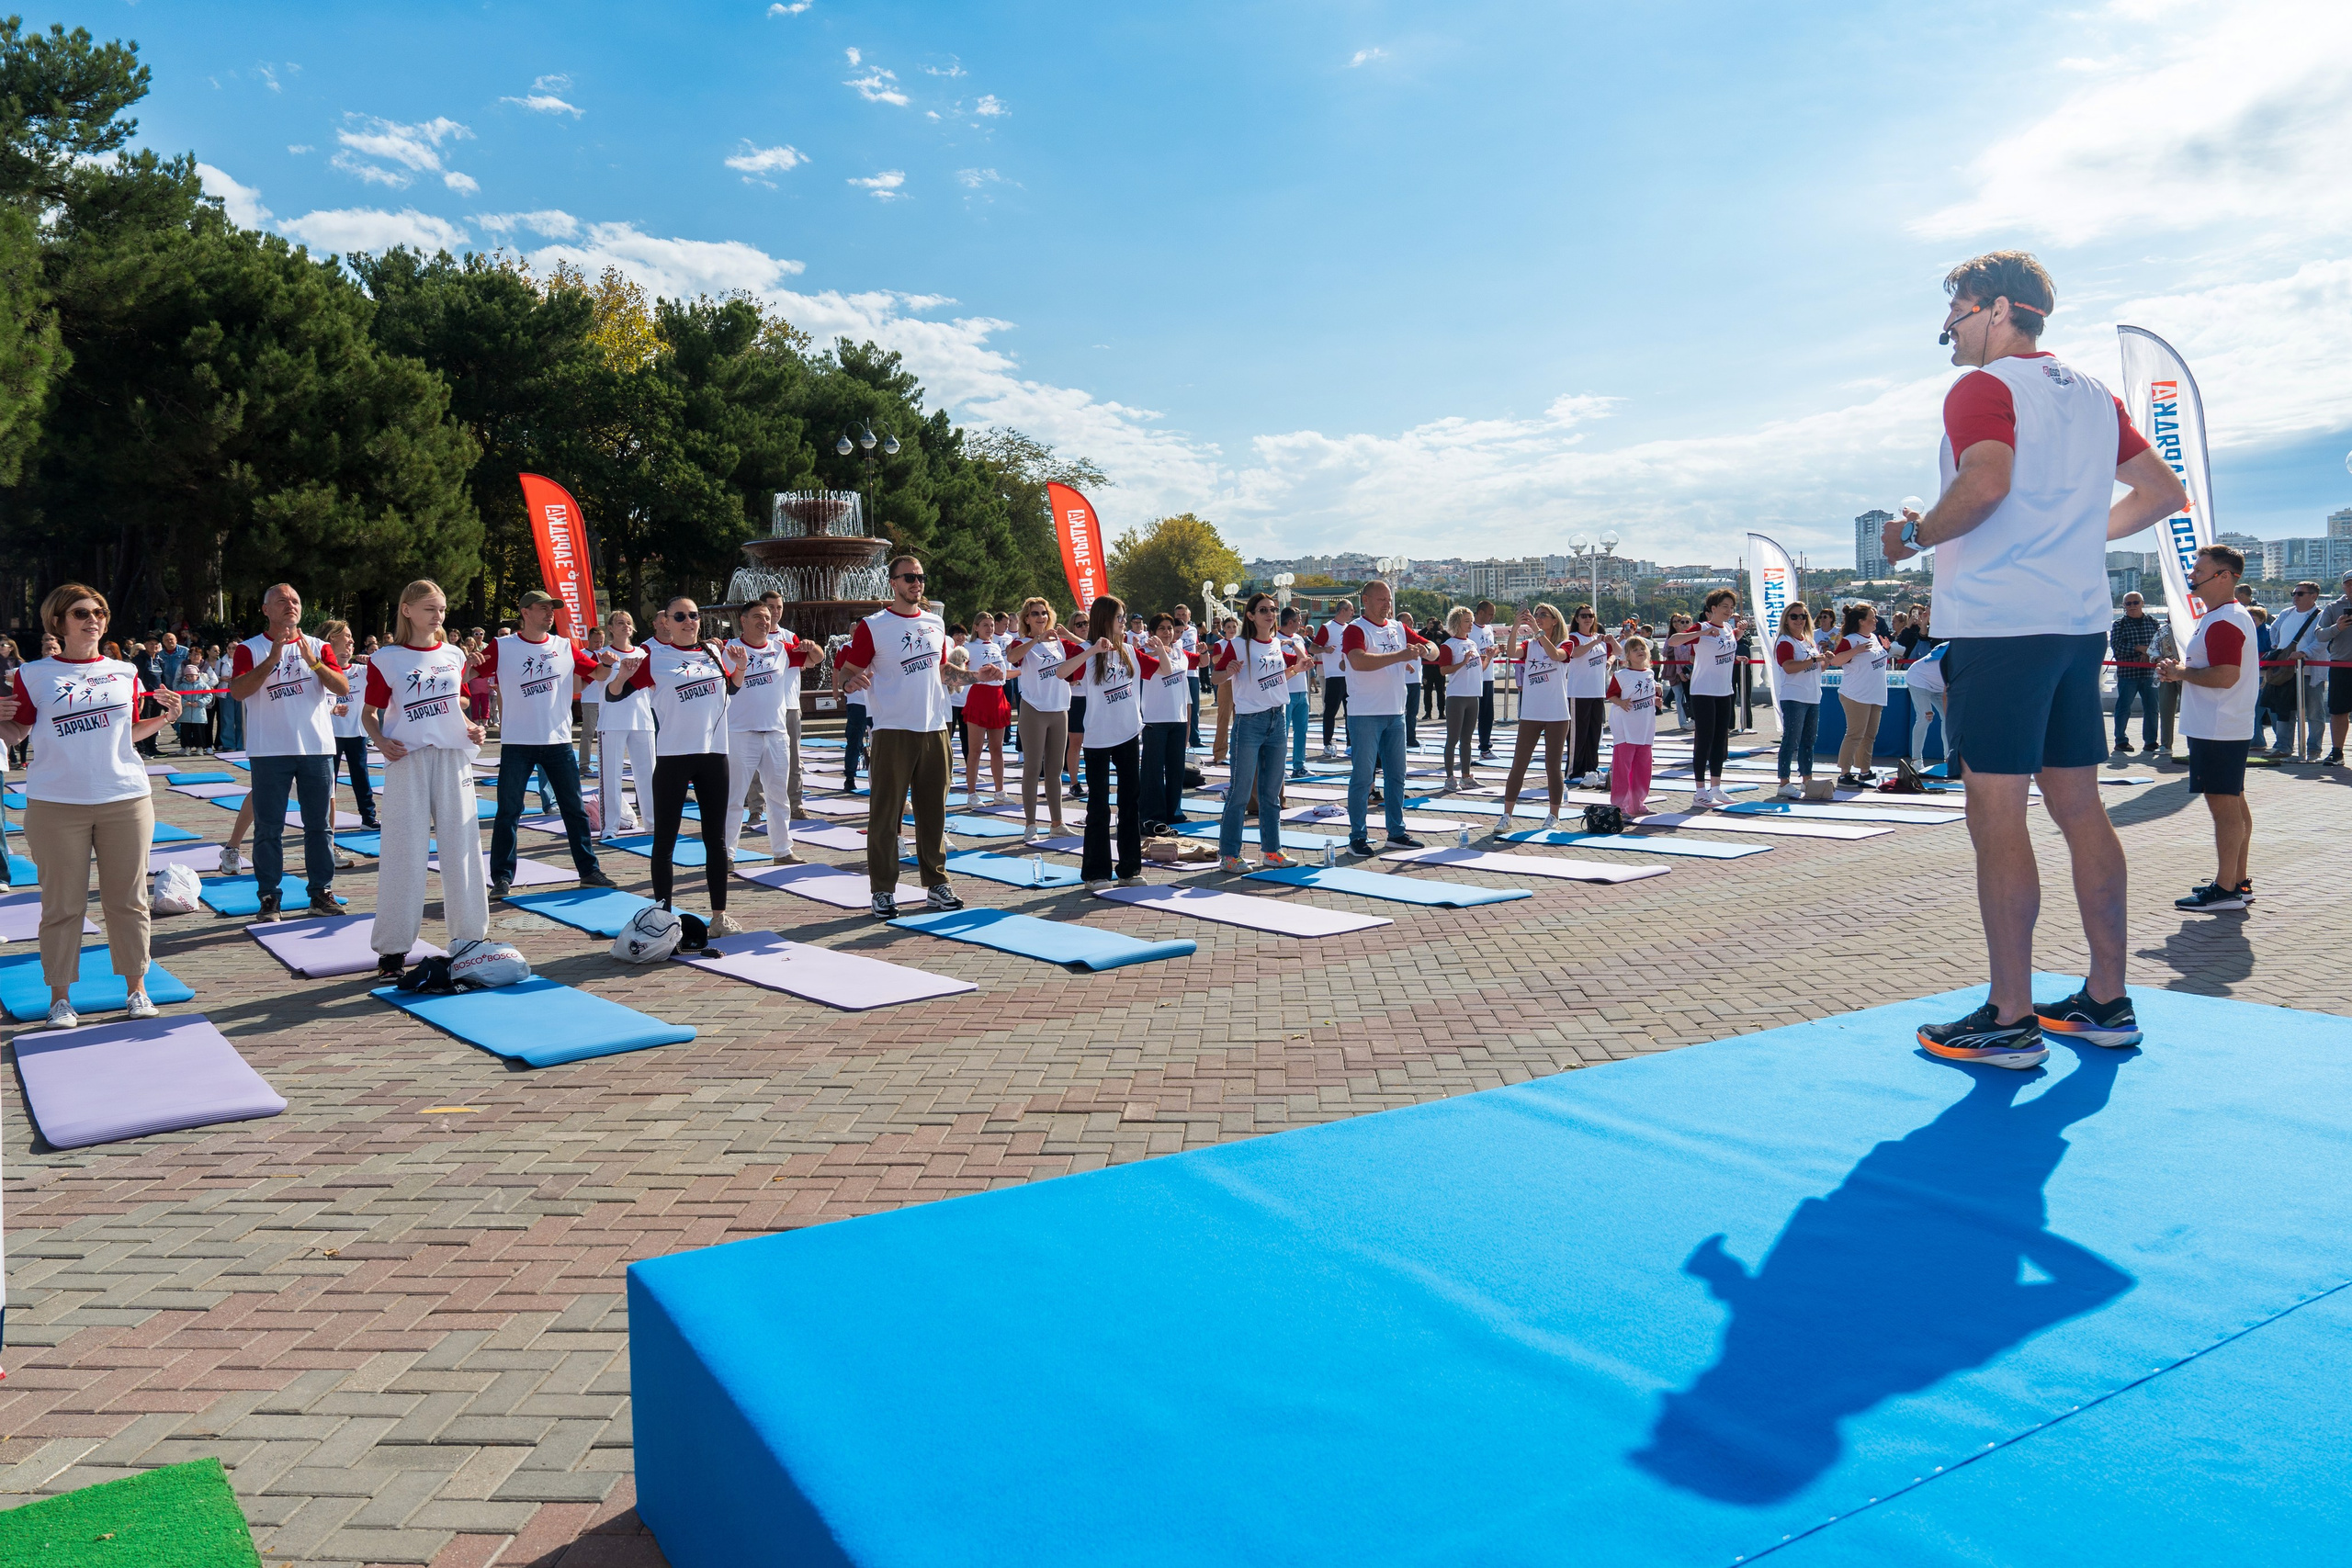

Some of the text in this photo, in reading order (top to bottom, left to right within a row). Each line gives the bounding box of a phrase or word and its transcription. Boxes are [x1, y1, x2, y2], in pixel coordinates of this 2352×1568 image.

[903, 658, 933, 675] ЗАРЯДКА
[87, 677, 111, 686] BOSCO
[522, 682, 553, 697] ЗАРЯДКА
[744, 675, 773, 688] ЗАРЯДКА
[268, 684, 303, 701] ЗАРЯДКА
[678, 682, 716, 703] ЗАРЯДКА
[1105, 688, 1132, 704] ЗАРЯДКА
[406, 701, 448, 722] ЗАРЯДКА
[55, 713, 109, 737] ЗАРЯДКА
[454, 953, 518, 971] BOSCO BOSCO
